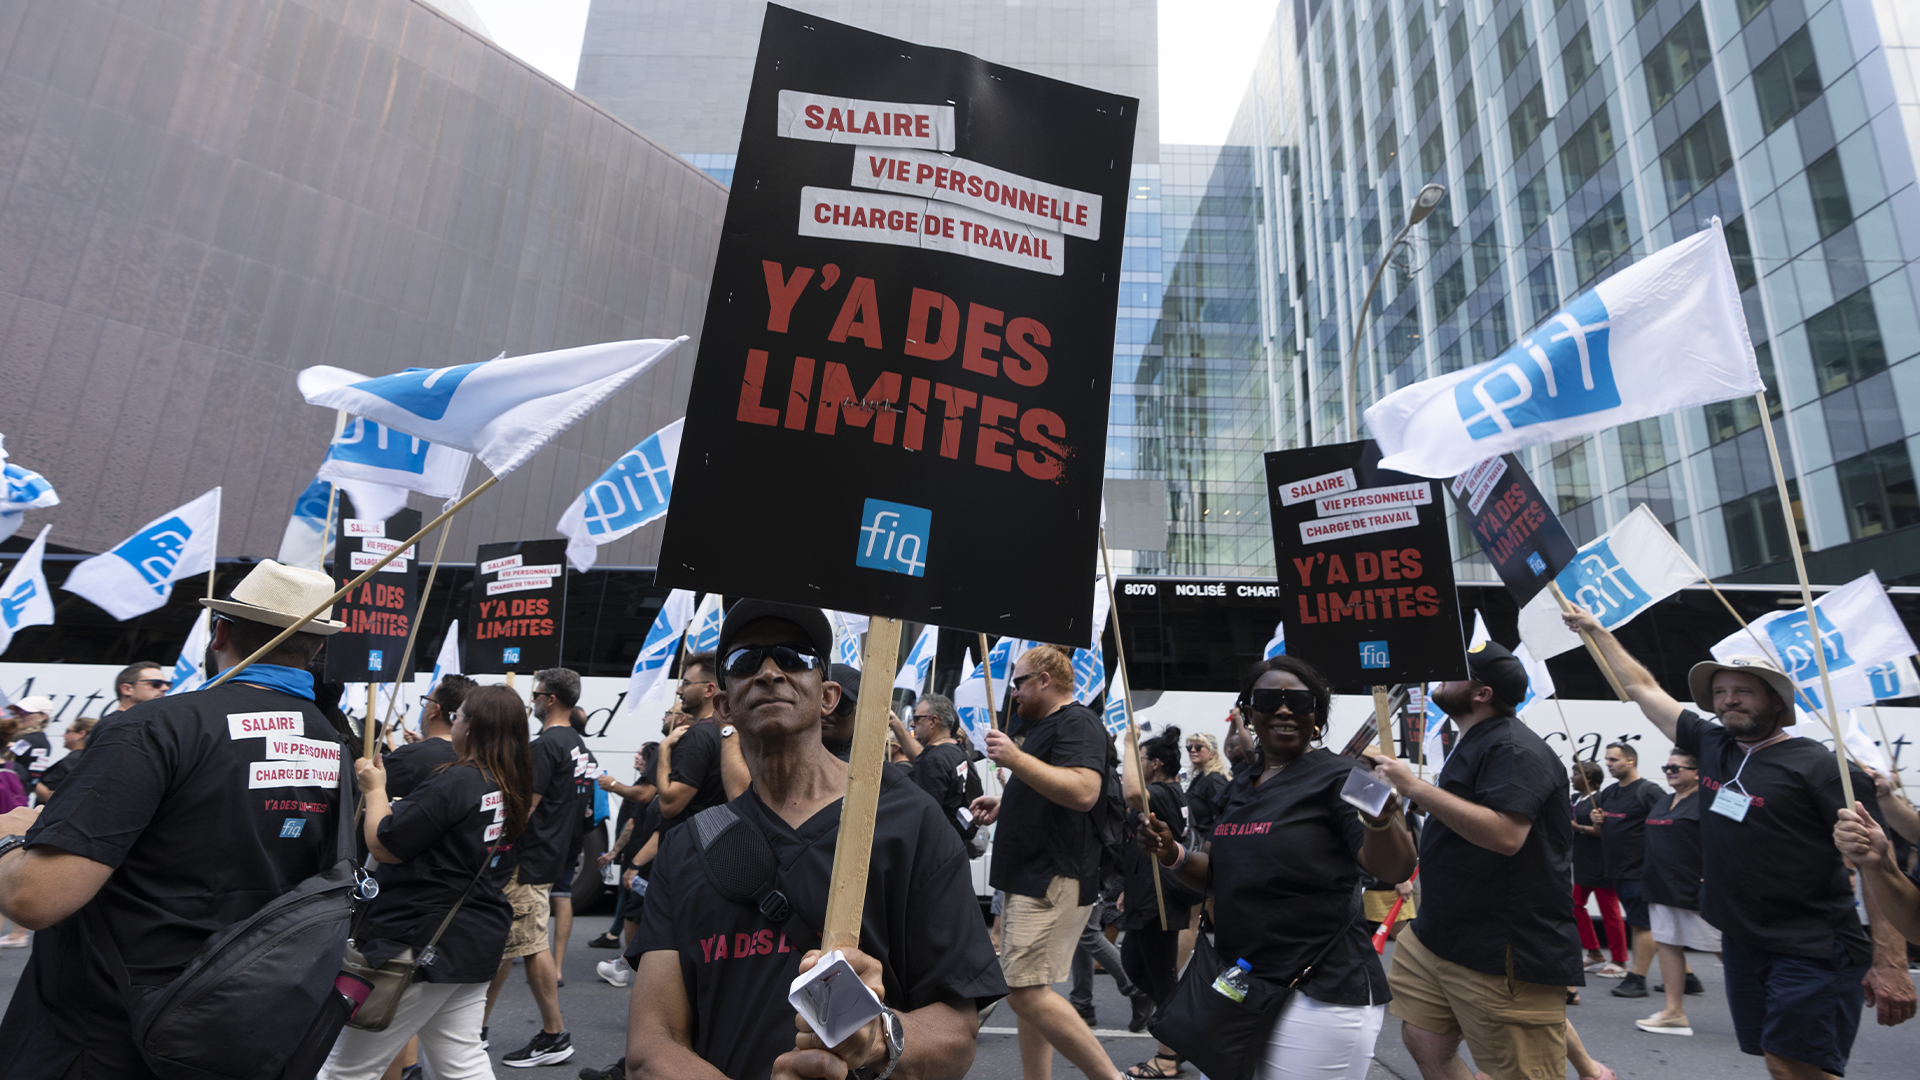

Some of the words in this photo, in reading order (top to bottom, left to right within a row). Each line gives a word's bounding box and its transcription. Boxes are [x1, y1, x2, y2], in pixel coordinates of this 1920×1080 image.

[804, 103, 931, 138] SALAIRE
[869, 155, 911, 182] VIE
[916, 162, 1088, 227] PERSONNELLE
[813, 202, 918, 233] CHARGE
[924, 214, 955, 239] DE
[959, 219, 1053, 261] TRAVAIL
[761, 259, 883, 350] Y'A
[904, 286, 1052, 387] DES
[736, 348, 1074, 484] LIMITES
[1290, 475, 1345, 499] SALAIRE
[1322, 498, 1342, 511] VIE
[1343, 488, 1425, 509] PERSONNELLE
[1494, 482, 1527, 523] DES
[1306, 520, 1351, 538] CHARGE
[1352, 518, 1367, 530] DE
[1367, 510, 1413, 527] TRAVAIL
[1490, 500, 1546, 566] LIMITES
[366, 540, 376, 549] VIE
[860, 509, 926, 576] fiq
[487, 558, 516, 570] SALAIRE
[512, 567, 558, 577] PERSONNELLE
[1292, 551, 1350, 587] Y'A
[1354, 547, 1423, 583] DES
[375, 583, 405, 609] DES
[490, 583, 514, 592] CHARGE
[524, 579, 549, 587] TRAVAIL
[1124, 583, 1156, 596] 8070
[1175, 582, 1227, 596] NOLISÉ
[511, 598, 550, 616] DES
[1297, 585, 1441, 624] LIMITES
[340, 608, 410, 638] LIMITES
[476, 618, 555, 640] LIMITES
[368, 652, 383, 671] fiq
[503, 649, 520, 664] fiq
[1359, 644, 1391, 669] fiq
[241, 717, 295, 732] SALAIRE
[273, 741, 288, 754] VIE
[255, 768, 294, 782] CHARGE
[295, 768, 309, 780] DE
[280, 799, 298, 811] DES
[298, 801, 328, 813] LIMITES
[1244, 821, 1273, 835] LIMIT
[700, 933, 729, 964] Y'A
[734, 928, 774, 959] DES
